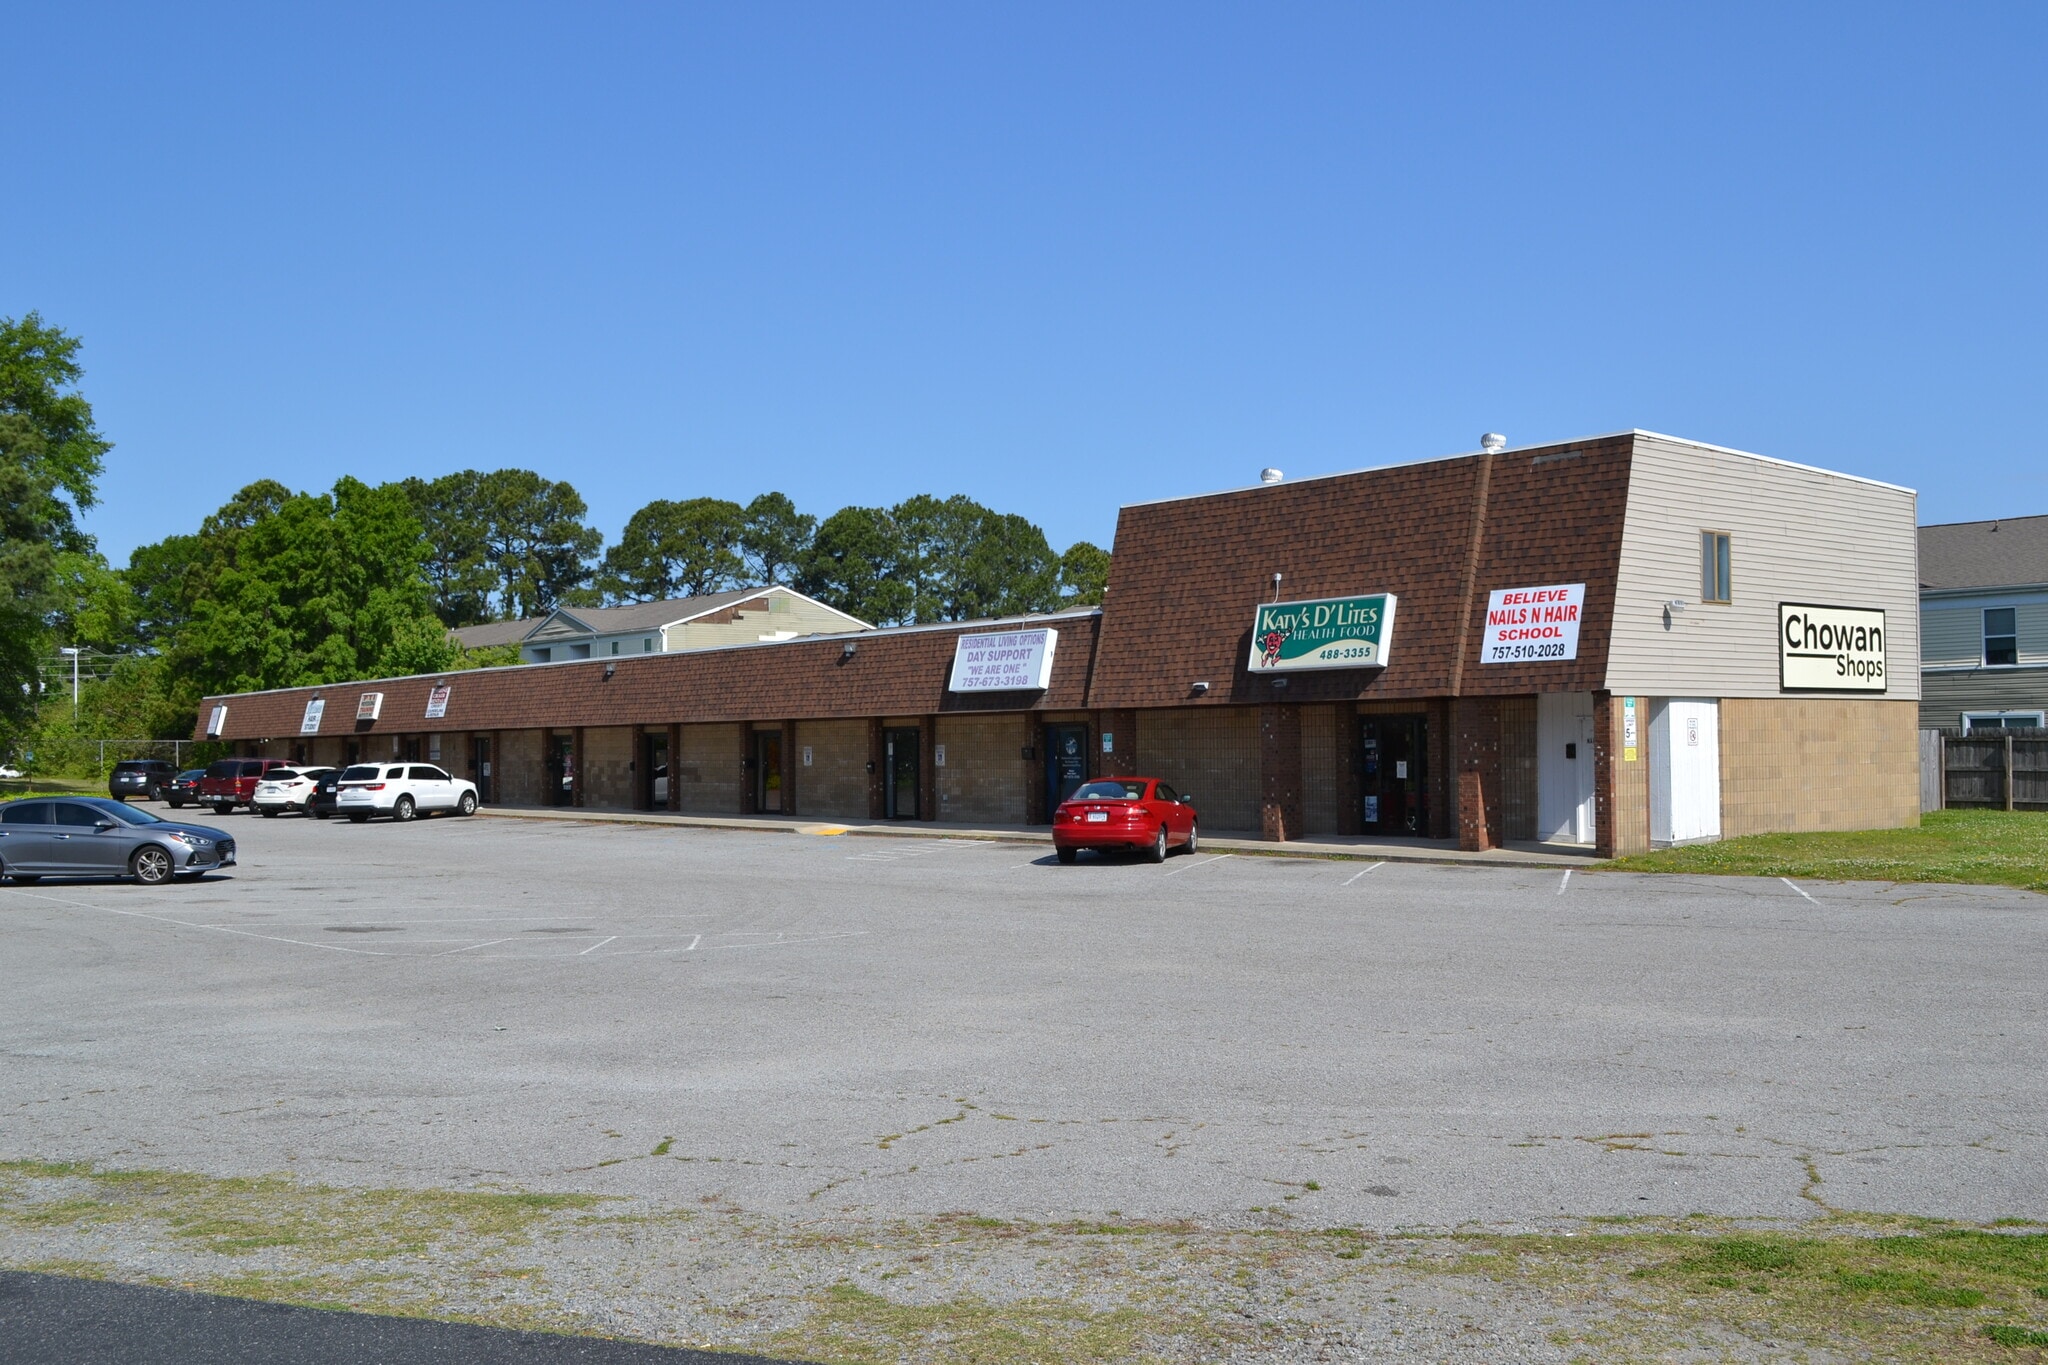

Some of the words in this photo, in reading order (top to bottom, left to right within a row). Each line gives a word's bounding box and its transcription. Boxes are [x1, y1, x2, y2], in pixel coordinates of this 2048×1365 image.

[1503, 589, 1568, 605] BELIEVE
[1488, 608, 1527, 626] NAILS
[1531, 607, 1541, 623] N
[1544, 605, 1578, 623] HAIR
[1293, 628, 1335, 641] HEALTH
[1340, 625, 1376, 638] FOOD
[1498, 626, 1563, 641] SCHOOL
[1785, 613, 1882, 652] Chowan
[961, 637, 996, 650] RESIDENTIAL
[998, 635, 1018, 647] LIVING
[1019, 633, 1045, 646] OPTIONS
[967, 651, 986, 662] DAY
[987, 648, 1033, 662] SUPPORT
[1320, 647, 1371, 660] 488-3355
[1492, 643, 1565, 659] 757-510-2028
[985, 664, 1001, 675] ARE
[1836, 653, 1883, 683] Shops
[962, 675, 1029, 688] 757-673-3198
[1625, 728, 1631, 739] 5
